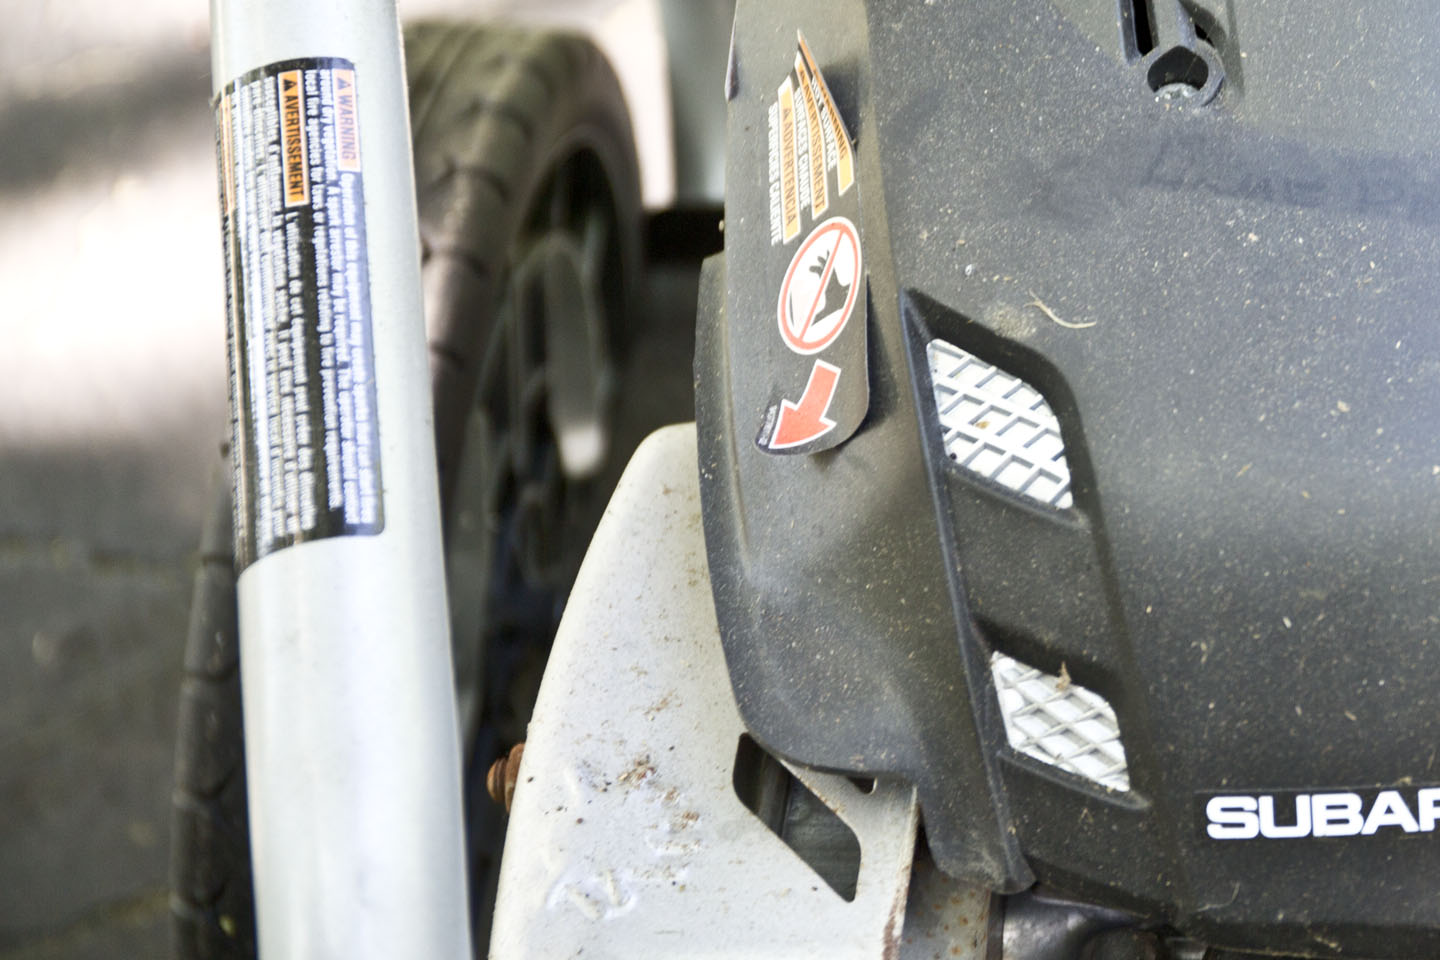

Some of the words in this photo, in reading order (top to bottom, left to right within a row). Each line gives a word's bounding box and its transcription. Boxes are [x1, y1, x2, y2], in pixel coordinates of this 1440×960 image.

[284, 94, 303, 196] AVERTISSEMENT
[339, 94, 355, 160] WARNING
[804, 84, 825, 209] AVERTISSEMENT
[820, 106, 837, 171] SURFACE
[769, 180, 782, 246] CALIENTE
[782, 116, 796, 226] ADVERTENCIA
